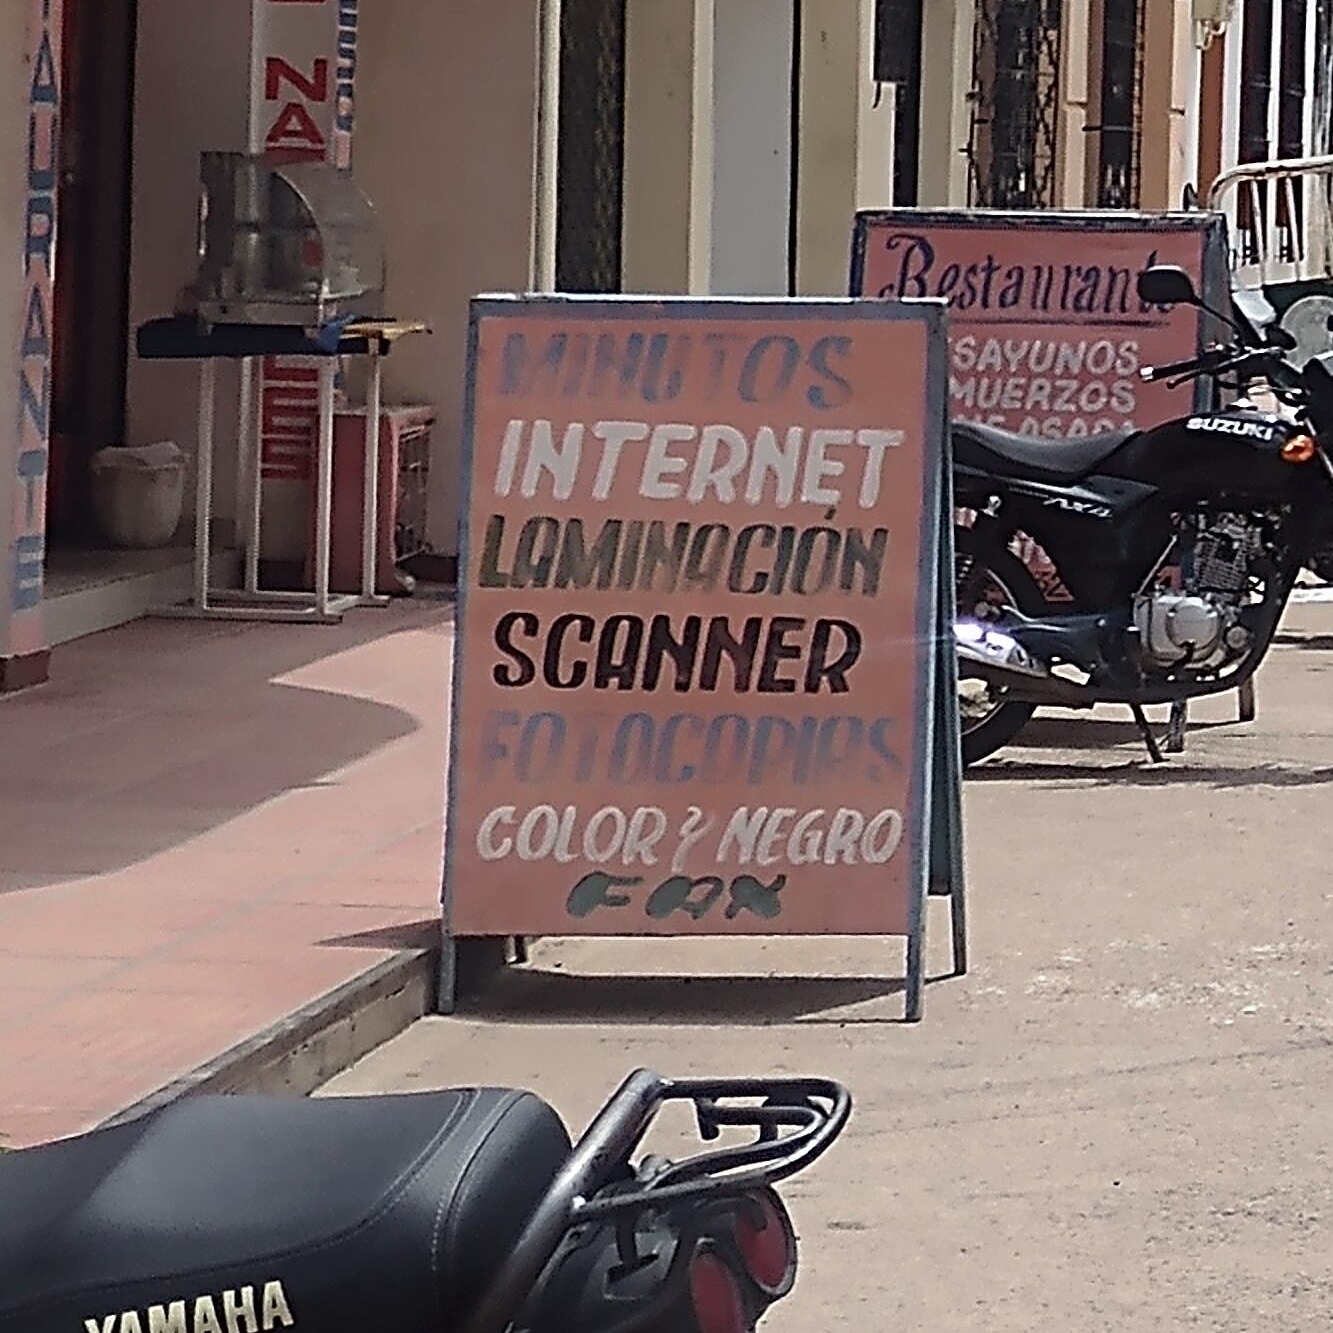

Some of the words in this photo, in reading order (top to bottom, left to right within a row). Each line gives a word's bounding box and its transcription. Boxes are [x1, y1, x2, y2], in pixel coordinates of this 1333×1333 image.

[879, 232, 1176, 314] Restaurant
[500, 330, 857, 412] MINUTOS
[947, 334, 1139, 377] SAYUNOS
[949, 375, 1137, 414] MUERZOS
[494, 419, 906, 509] INTERNET
[1186, 417, 1275, 442] SUZUKI
[478, 506, 889, 598] LAMINACIÓN
[492, 612, 863, 695] SCANNER
[478, 711, 905, 786] FOTOCOPIAS
[476, 803, 666, 867] COLOR
[717, 805, 904, 867] NEGRO
[566, 870, 788, 921] FAX
[83, 1279, 296, 1333] MAHA
